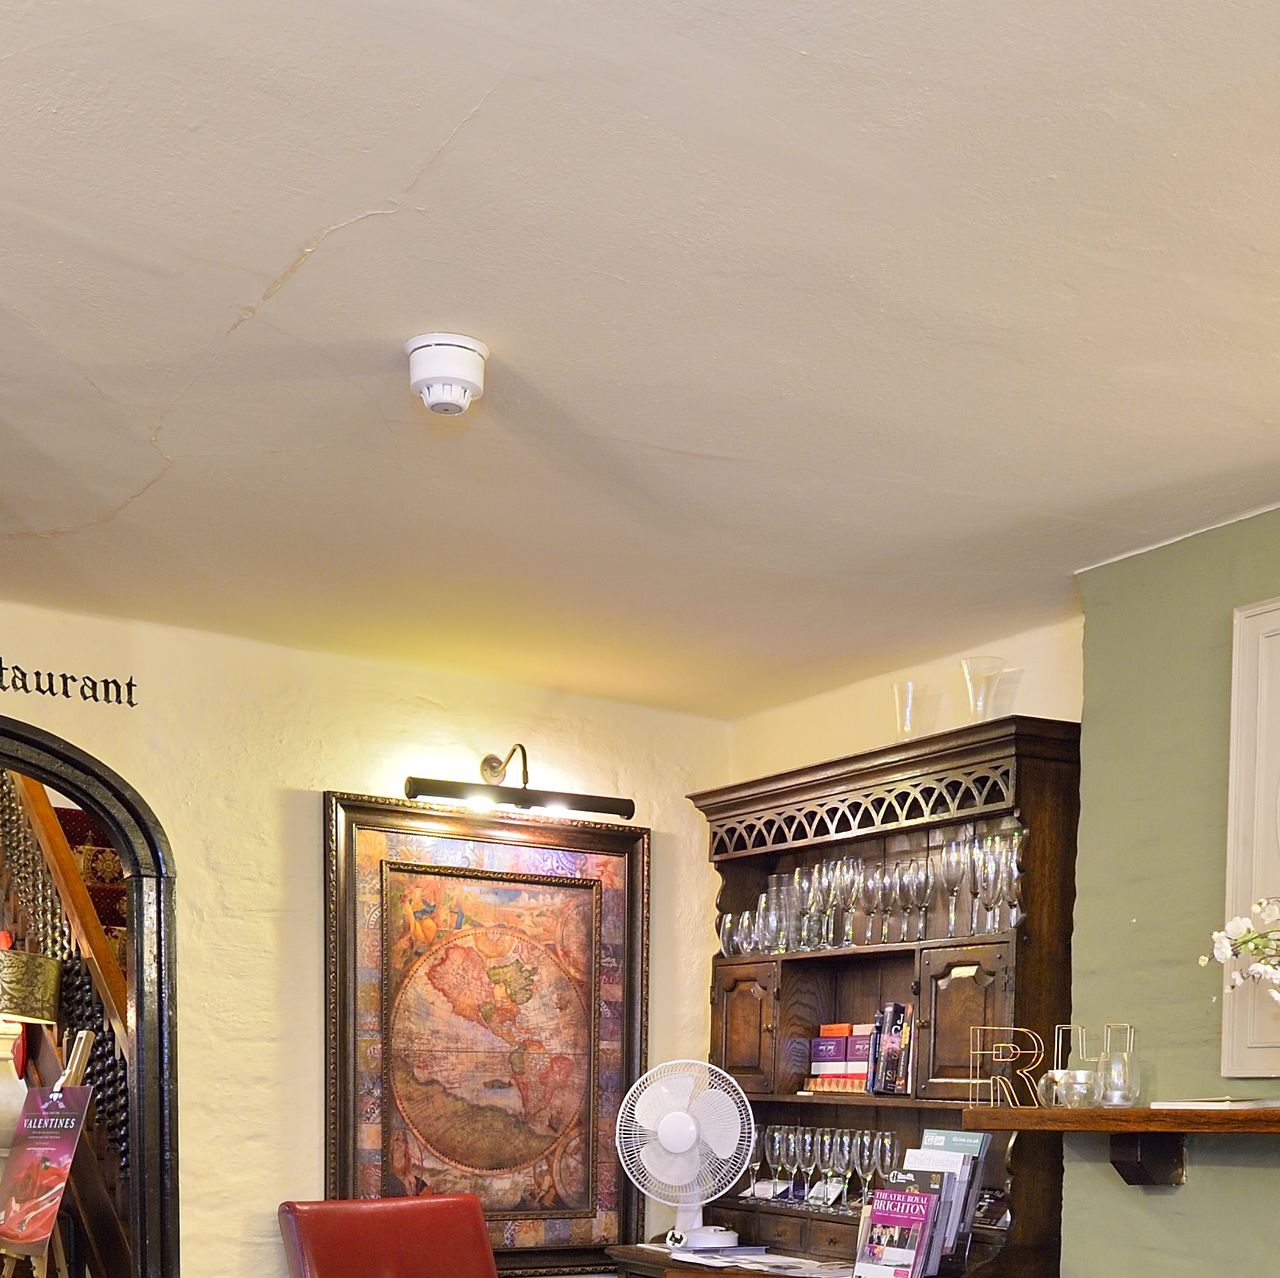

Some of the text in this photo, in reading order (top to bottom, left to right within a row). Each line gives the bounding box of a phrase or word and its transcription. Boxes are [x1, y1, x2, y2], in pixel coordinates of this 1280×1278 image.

[23, 1118, 76, 1129] VALENTINES
[875, 1191, 928, 1205] THEATRE ROYAL
[873, 1199, 927, 1216] BRIGHTON
